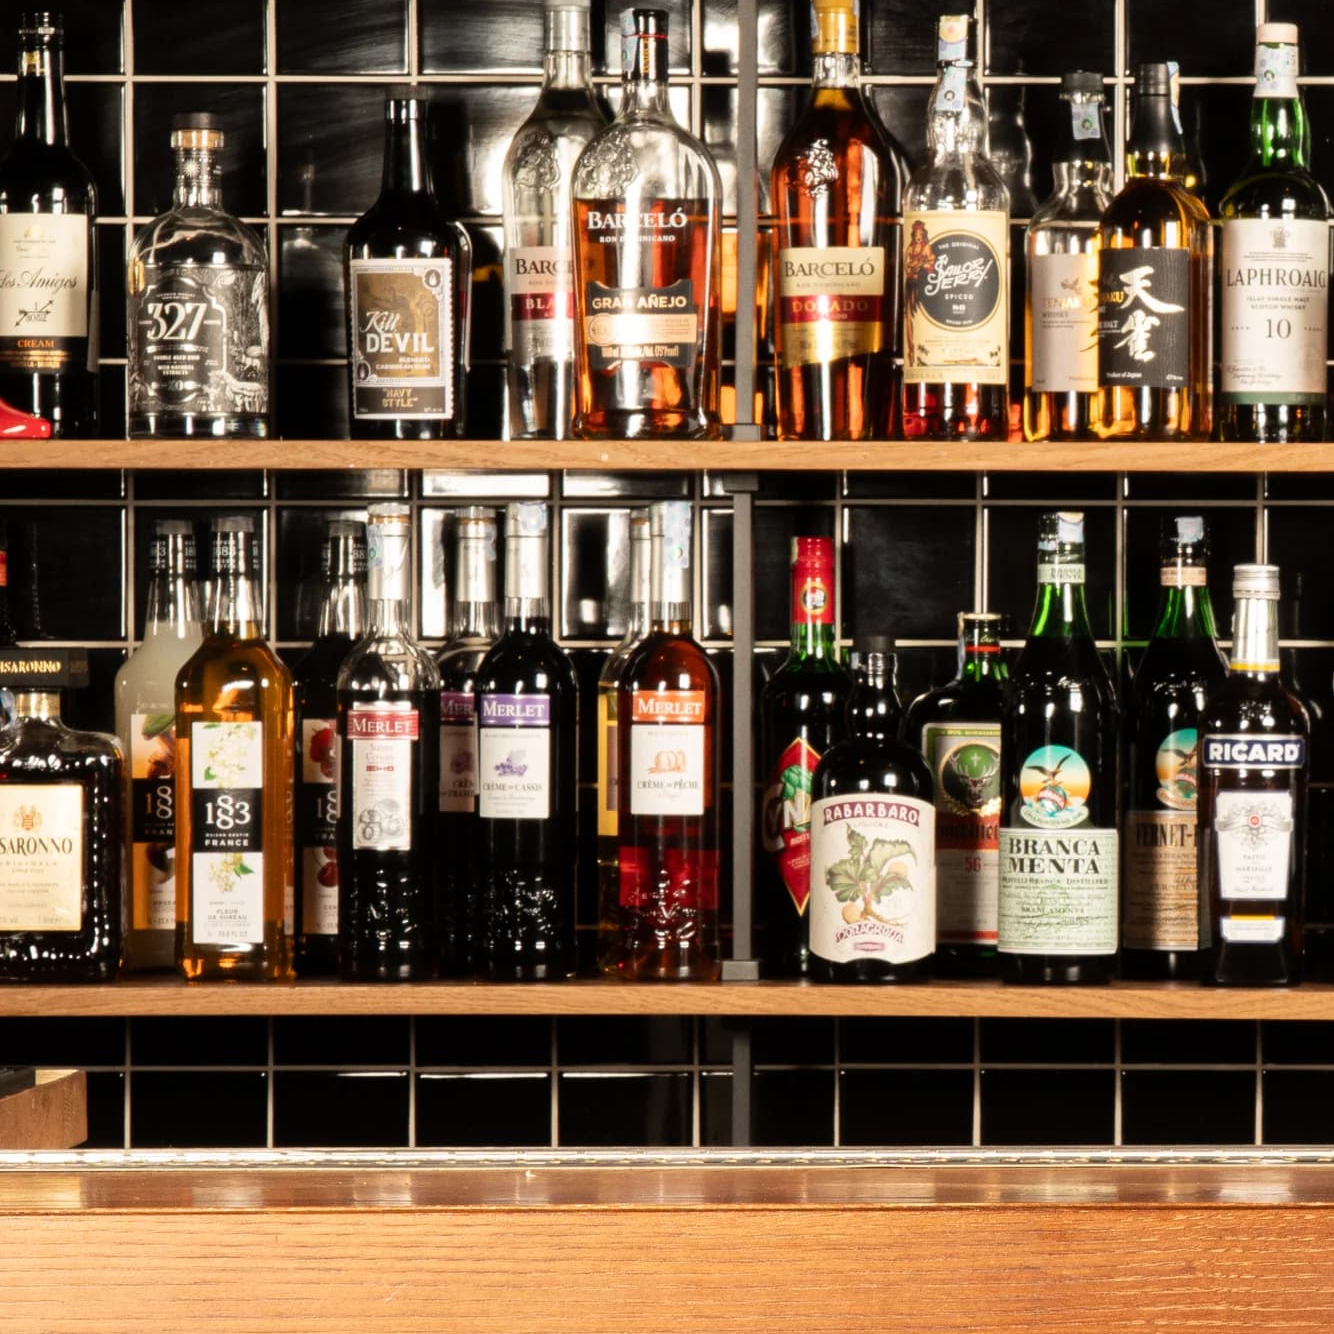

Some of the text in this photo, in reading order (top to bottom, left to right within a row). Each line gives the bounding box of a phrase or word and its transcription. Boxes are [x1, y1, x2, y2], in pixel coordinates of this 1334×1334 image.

[784, 257, 875, 278] BARCELÓ
[19, 267, 78, 295] Amigos
[1226, 268, 1327, 289] LAPHROAIG
[637, 294, 688, 309] AÑEJO
[792, 301, 869, 313] DOADO
[146, 302, 207, 340] 327
[360, 311, 400, 333] Kill
[1265, 318, 1292, 340] 10
[17, 339, 55, 348] CREAM
[366, 332, 435, 354] DEVIL
[483, 703, 545, 717] MERLET
[637, 698, 702, 716] MERLET
[352, 719, 411, 733] MERLET
[1208, 742, 1299, 762] RICARD
[482, 781, 543, 792] CRÈME CASSIS
[825, 801, 919, 826] RABARBARO
[205, 839, 250, 847] FRANCE
[1009, 837, 1101, 856] BRANCA
[1008, 857, 1100, 875] MENTA
